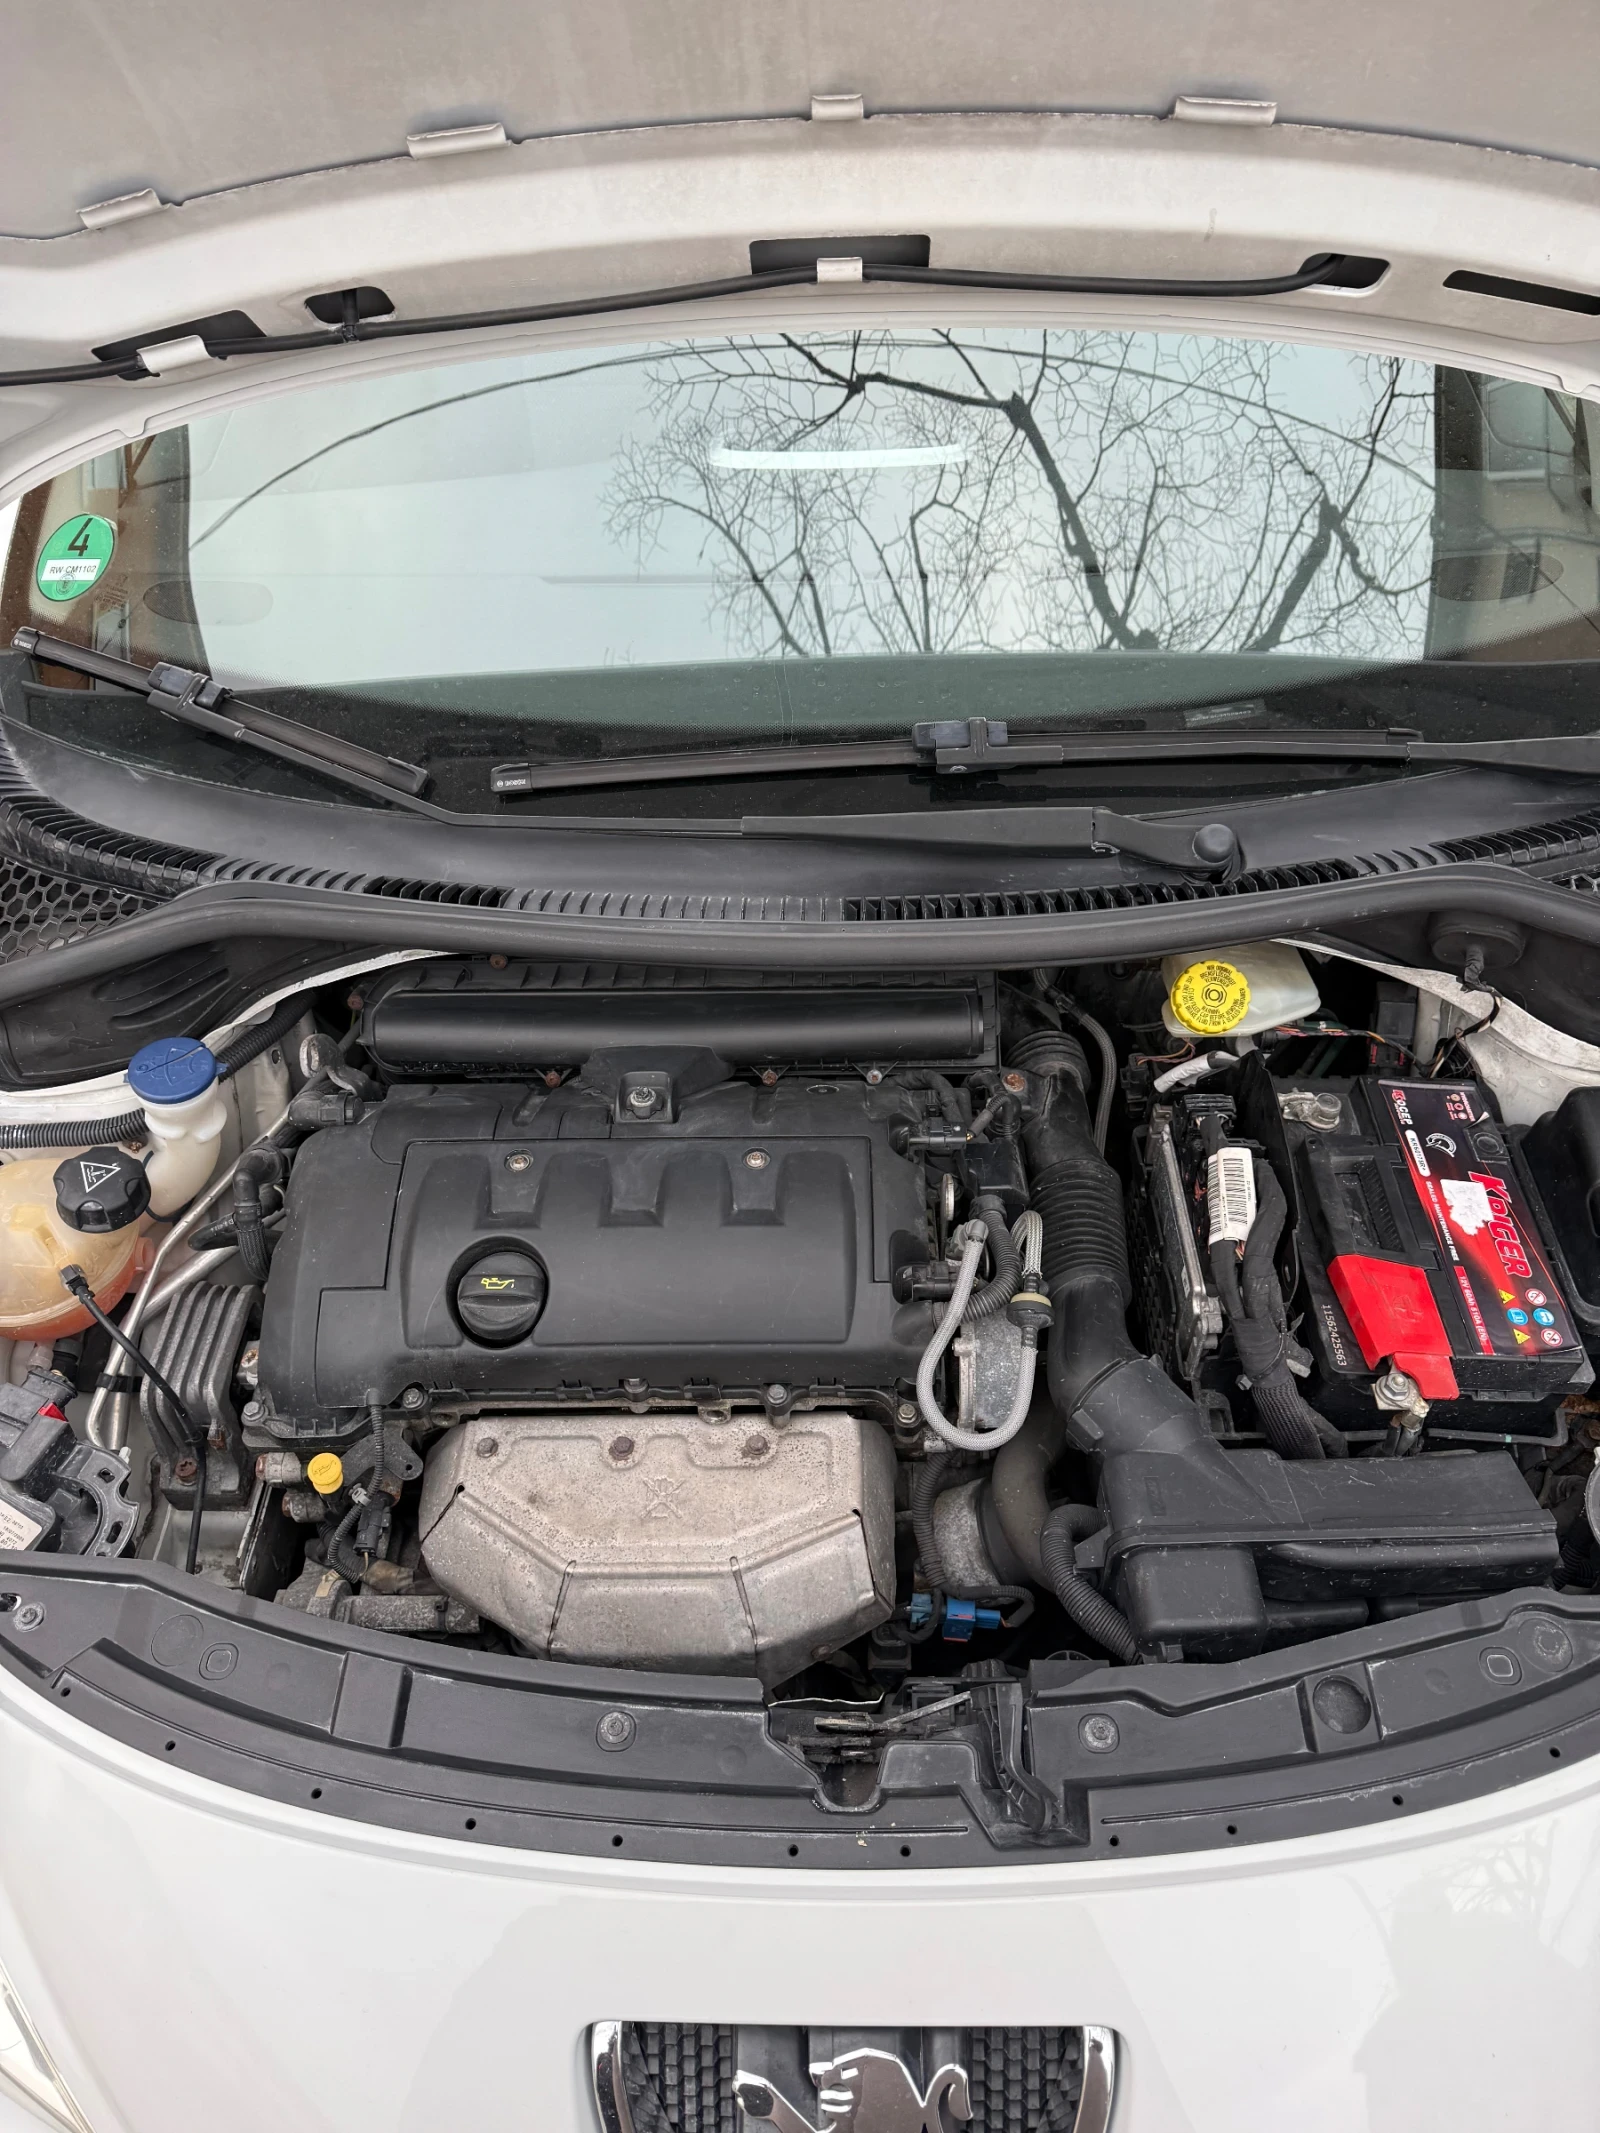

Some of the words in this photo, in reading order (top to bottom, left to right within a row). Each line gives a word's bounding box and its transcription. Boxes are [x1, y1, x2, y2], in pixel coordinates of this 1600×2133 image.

[67, 517, 94, 557] 4
[1426, 1181, 1438, 1203] SEALED
[1434, 1203, 1454, 1245] MAINTENANCE
[1449, 1245, 1460, 1261] FREE
[1460, 1276, 1470, 1289] 12V
[1321, 1304, 1347, 1366] 11562425563
